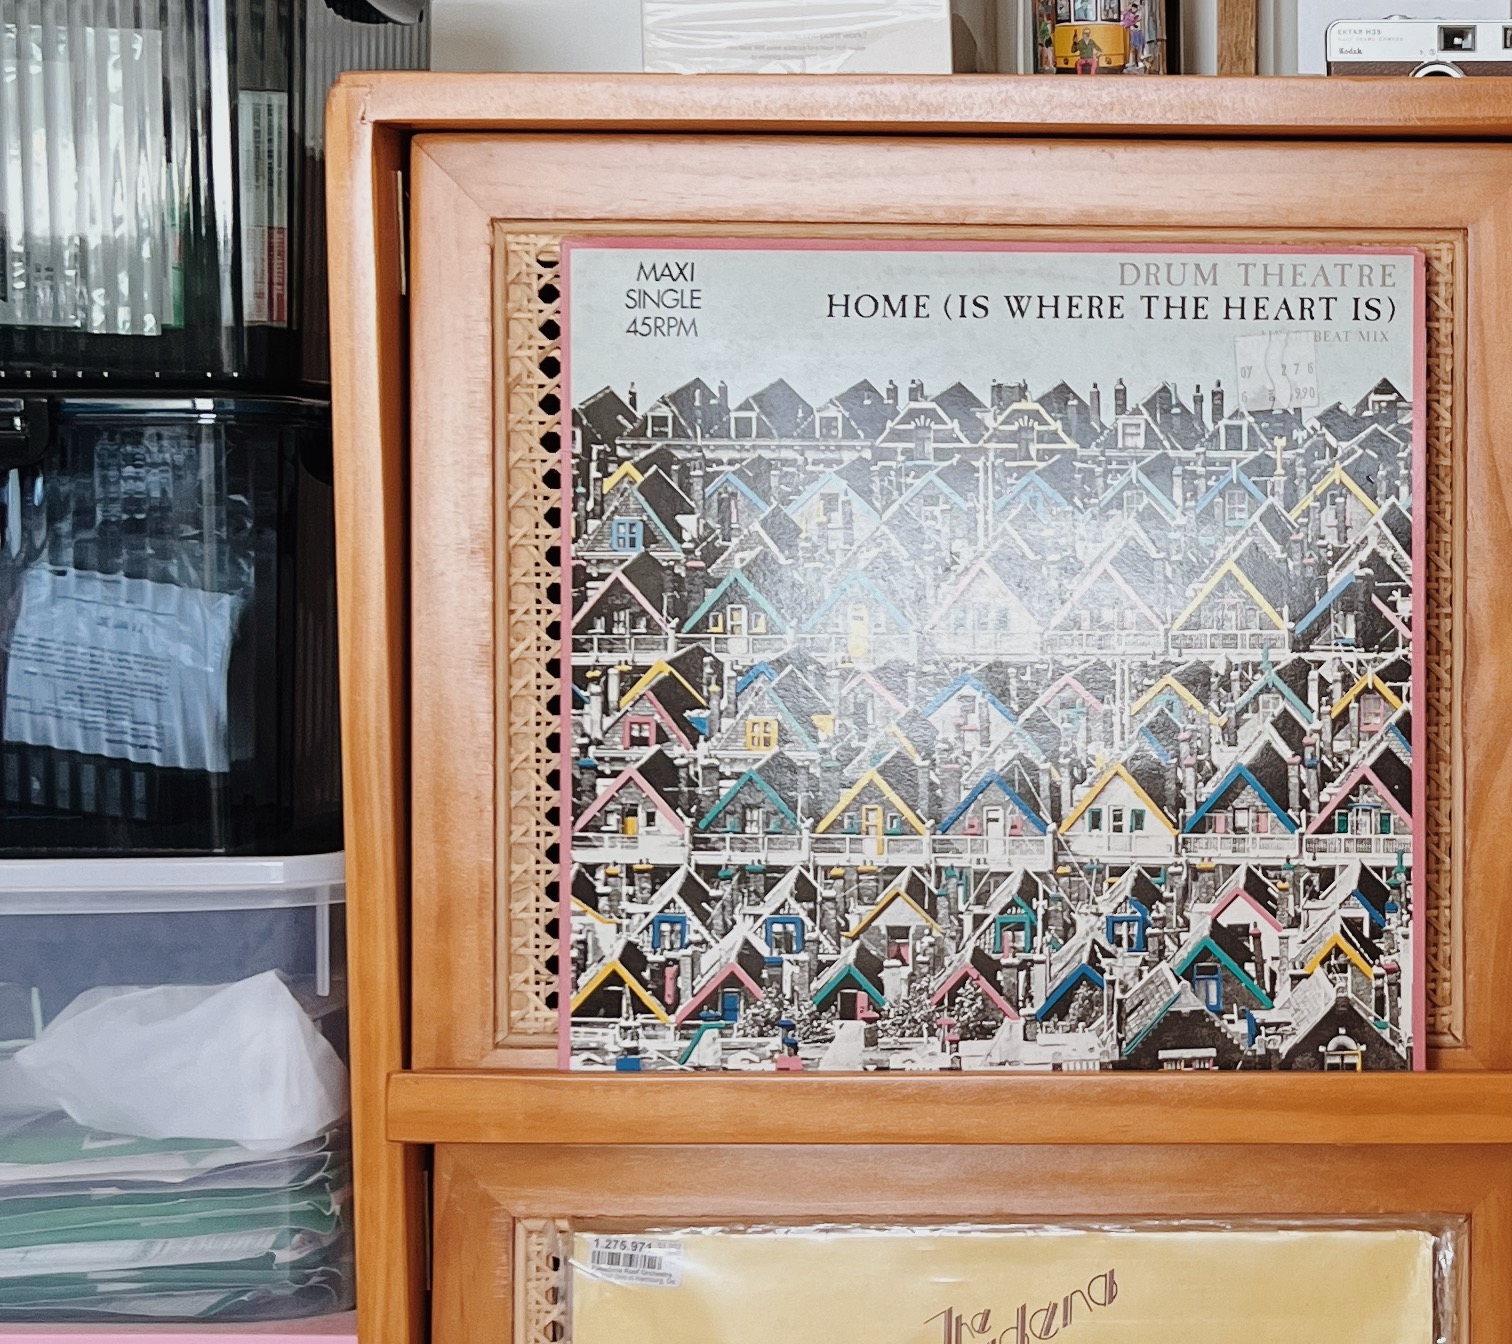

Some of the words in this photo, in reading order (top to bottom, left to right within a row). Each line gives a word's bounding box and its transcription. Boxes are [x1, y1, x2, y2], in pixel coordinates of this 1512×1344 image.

[636, 261, 695, 282] MAXI
[1118, 262, 1221, 288] DRUM
[1236, 262, 1397, 288] THEATRE
[625, 288, 702, 309] SINGLE
[826, 293, 931, 321] HOME
[944, 293, 991, 323] (IS
[1004, 293, 1126, 321] WHERE
[1140, 293, 1210, 321] THE
[1222, 293, 1339, 321] HEART
[1352, 292, 1398, 323] IS)
[625, 316, 698, 337] 45RPM
[1358, 330, 1389, 343] MIX
